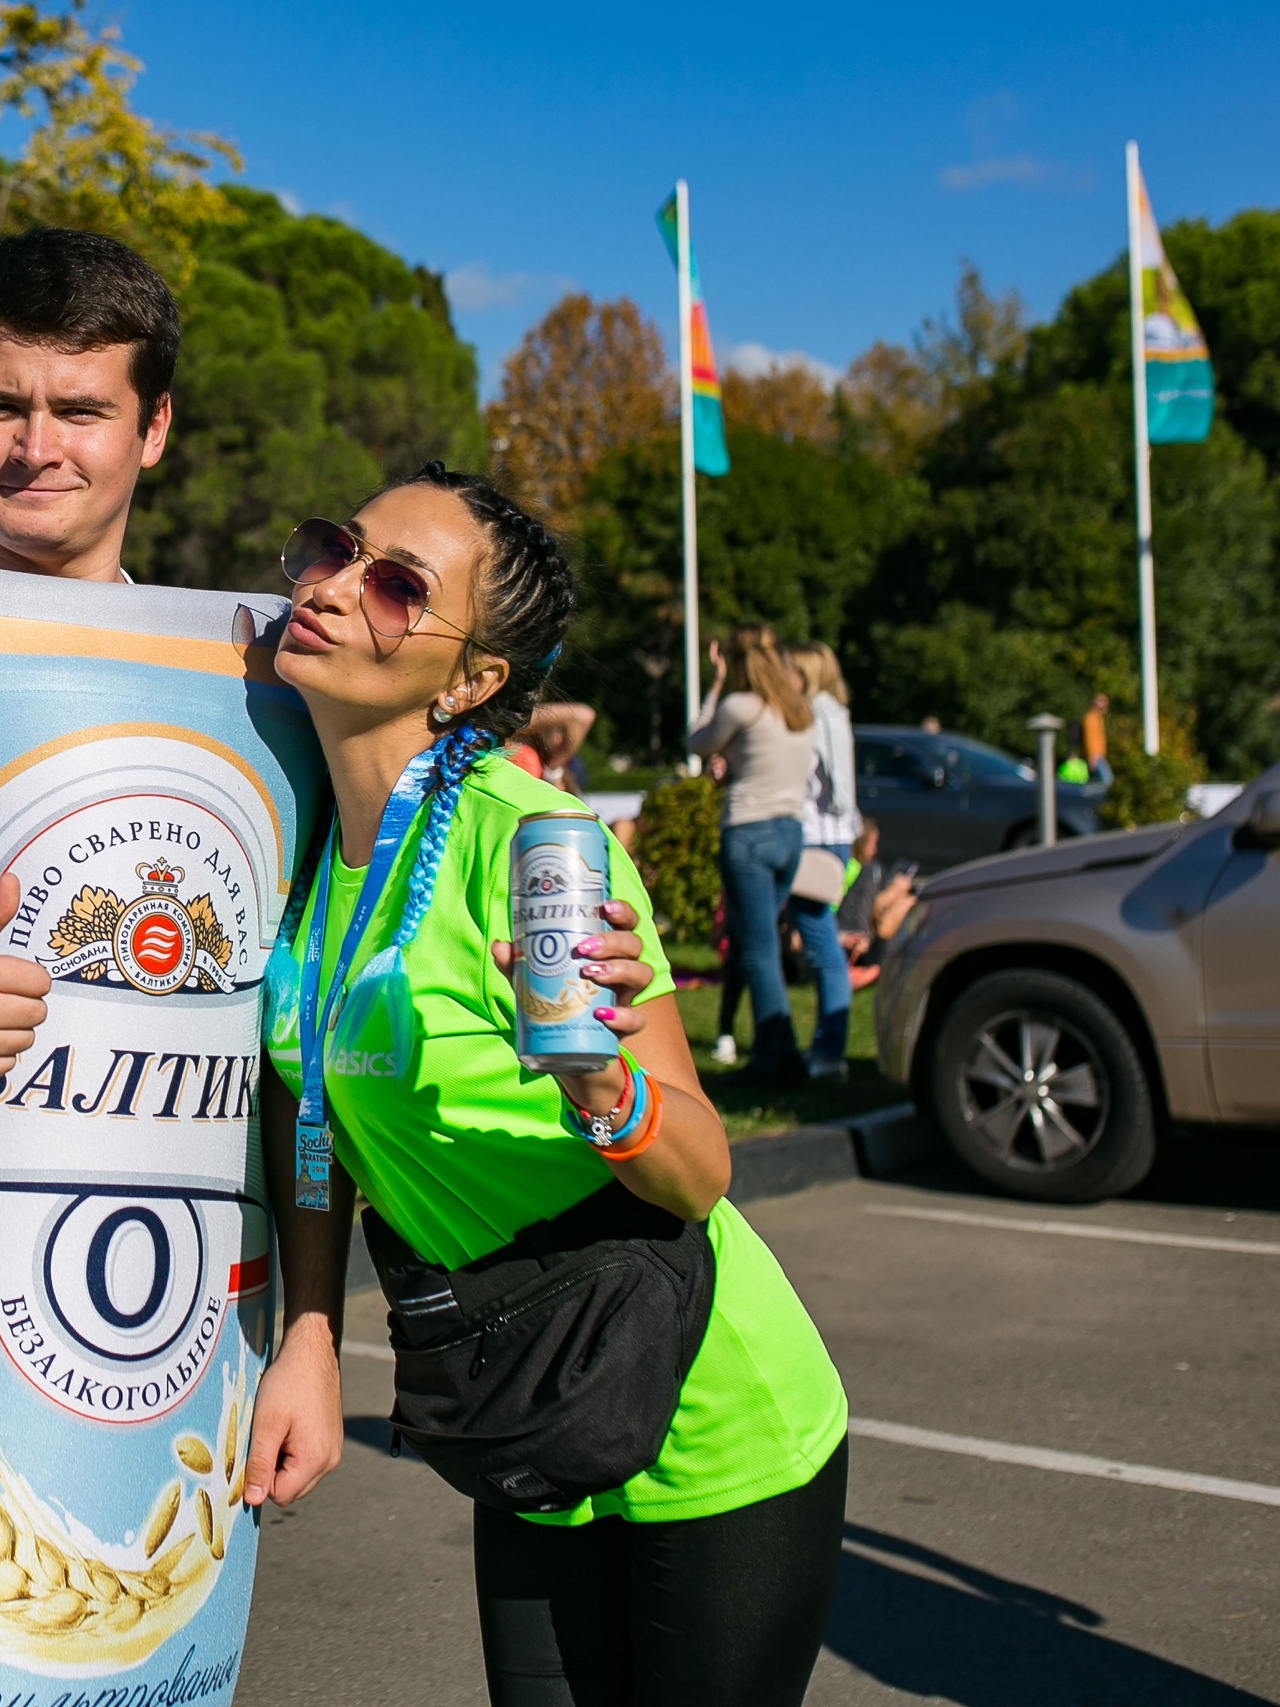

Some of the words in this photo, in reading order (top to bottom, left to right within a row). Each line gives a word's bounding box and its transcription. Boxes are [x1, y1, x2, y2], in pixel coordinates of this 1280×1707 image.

[9, 866, 63, 949] ПИВО
[68, 820, 201, 864] СВАРЕНО
[204, 848, 241, 902] ДЛЯ
[235, 906, 249, 966] ВАС
[122, 901, 170, 962] ПИВОВАРЕННАЯ
[172, 904, 193, 968] КОМПАНИЯ
[51, 945, 109, 975] ОСНОВАНА
[134, 970, 178, 987] БАЛТИКА
[298, 1130, 333, 1154] Sochi
[0, 1294, 221, 1412] БЕЗАЛКОГОЛЬНОЕ
